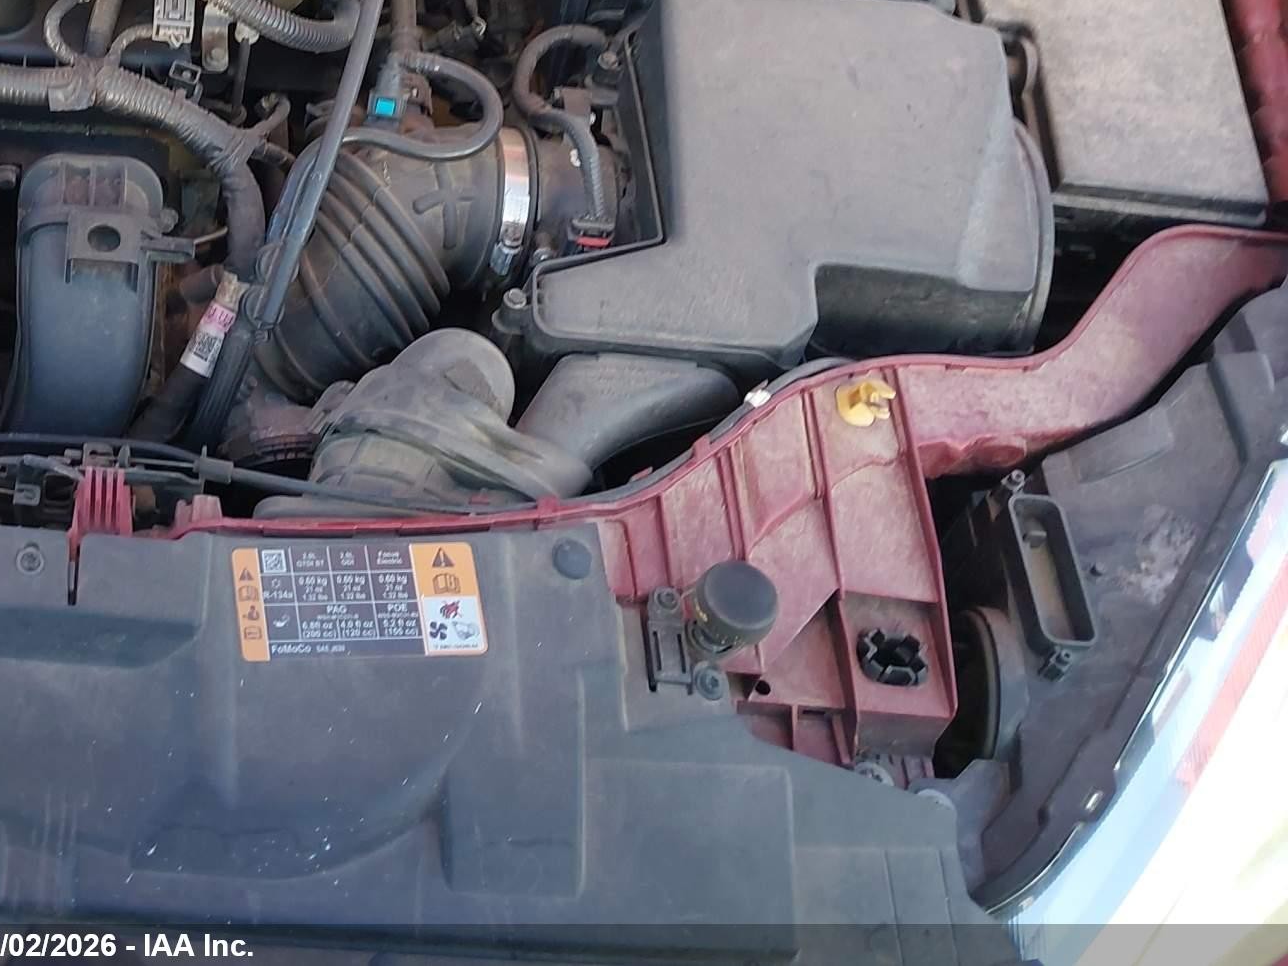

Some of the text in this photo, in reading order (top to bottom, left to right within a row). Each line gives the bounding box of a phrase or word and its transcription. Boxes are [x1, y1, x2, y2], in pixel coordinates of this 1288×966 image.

[316, 576, 328, 586] kg
[354, 574, 366, 585] kg
[396, 574, 408, 585] kg
[263, 590, 293, 599] R-134a
[326, 605, 347, 614] PAG
[387, 603, 408, 612] POE
[271, 643, 312, 654] FoMoCo
